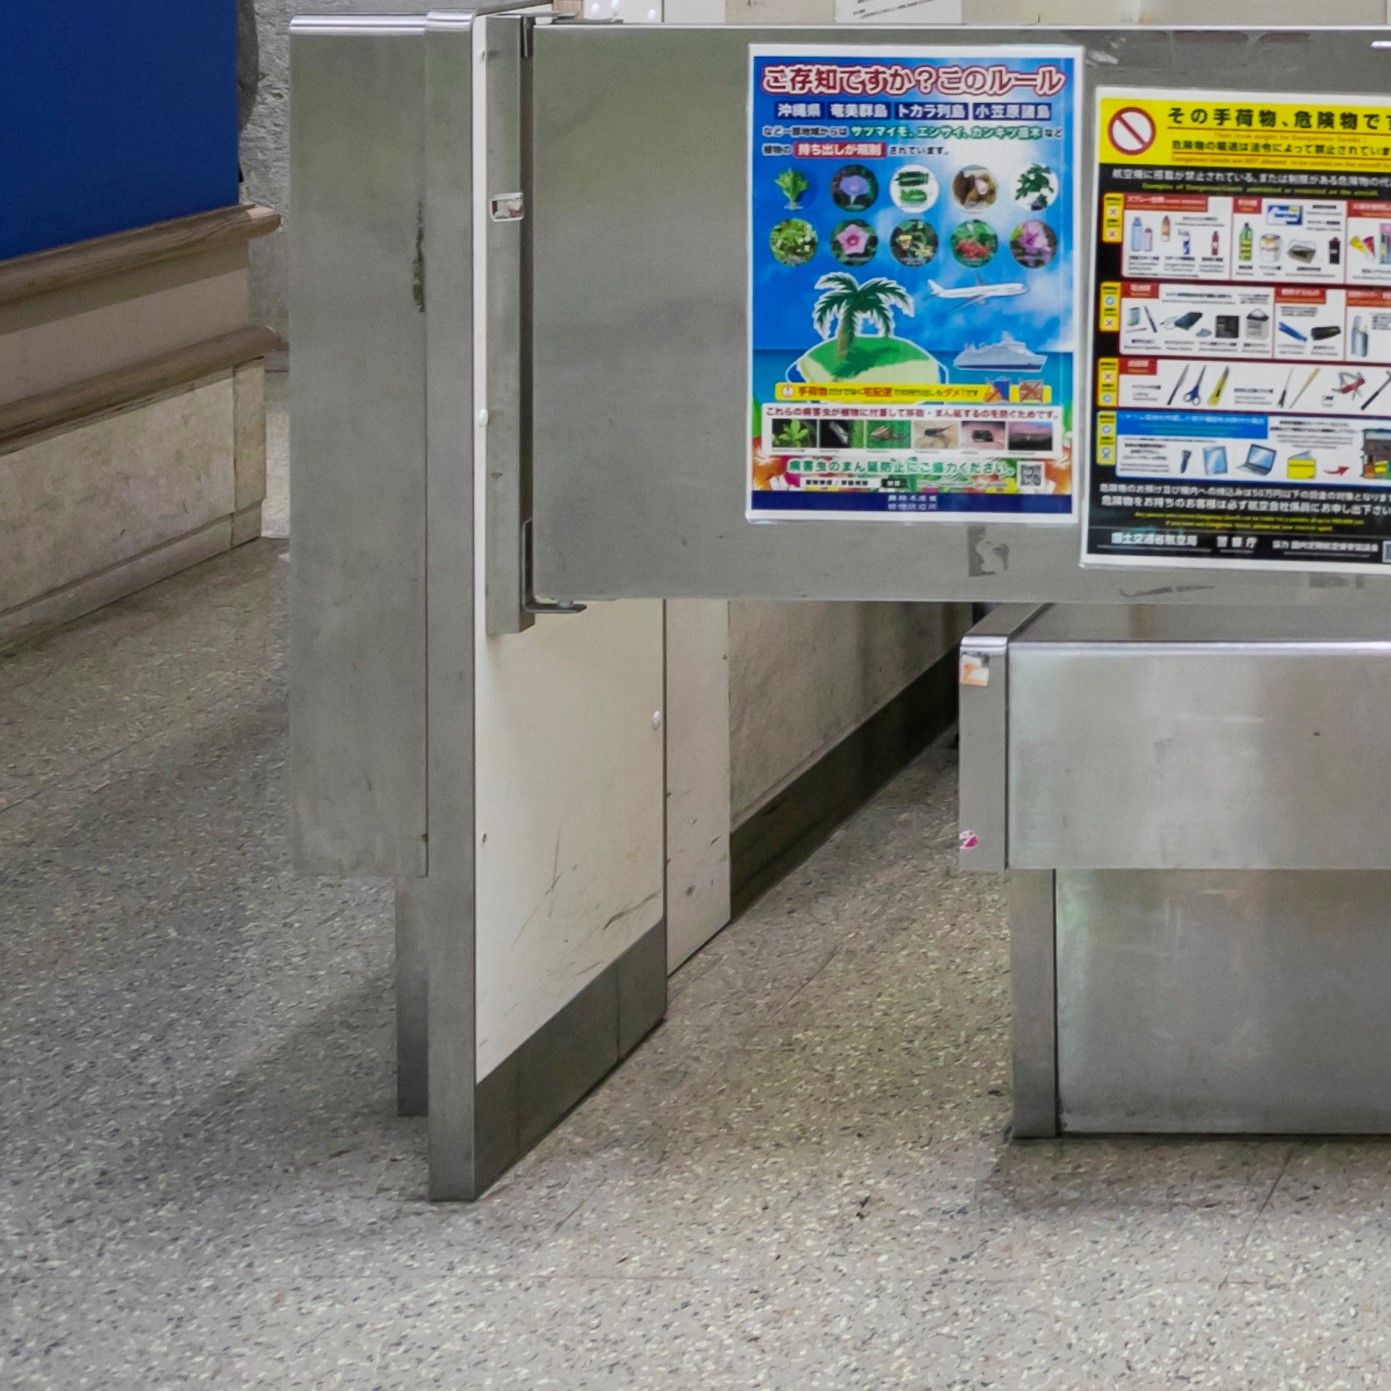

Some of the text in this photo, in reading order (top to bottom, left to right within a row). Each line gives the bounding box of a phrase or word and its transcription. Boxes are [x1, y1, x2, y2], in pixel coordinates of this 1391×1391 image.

[777, 103, 1050, 120] 沖縄県 奄美群島 トカラ列島 小笠原諸島
